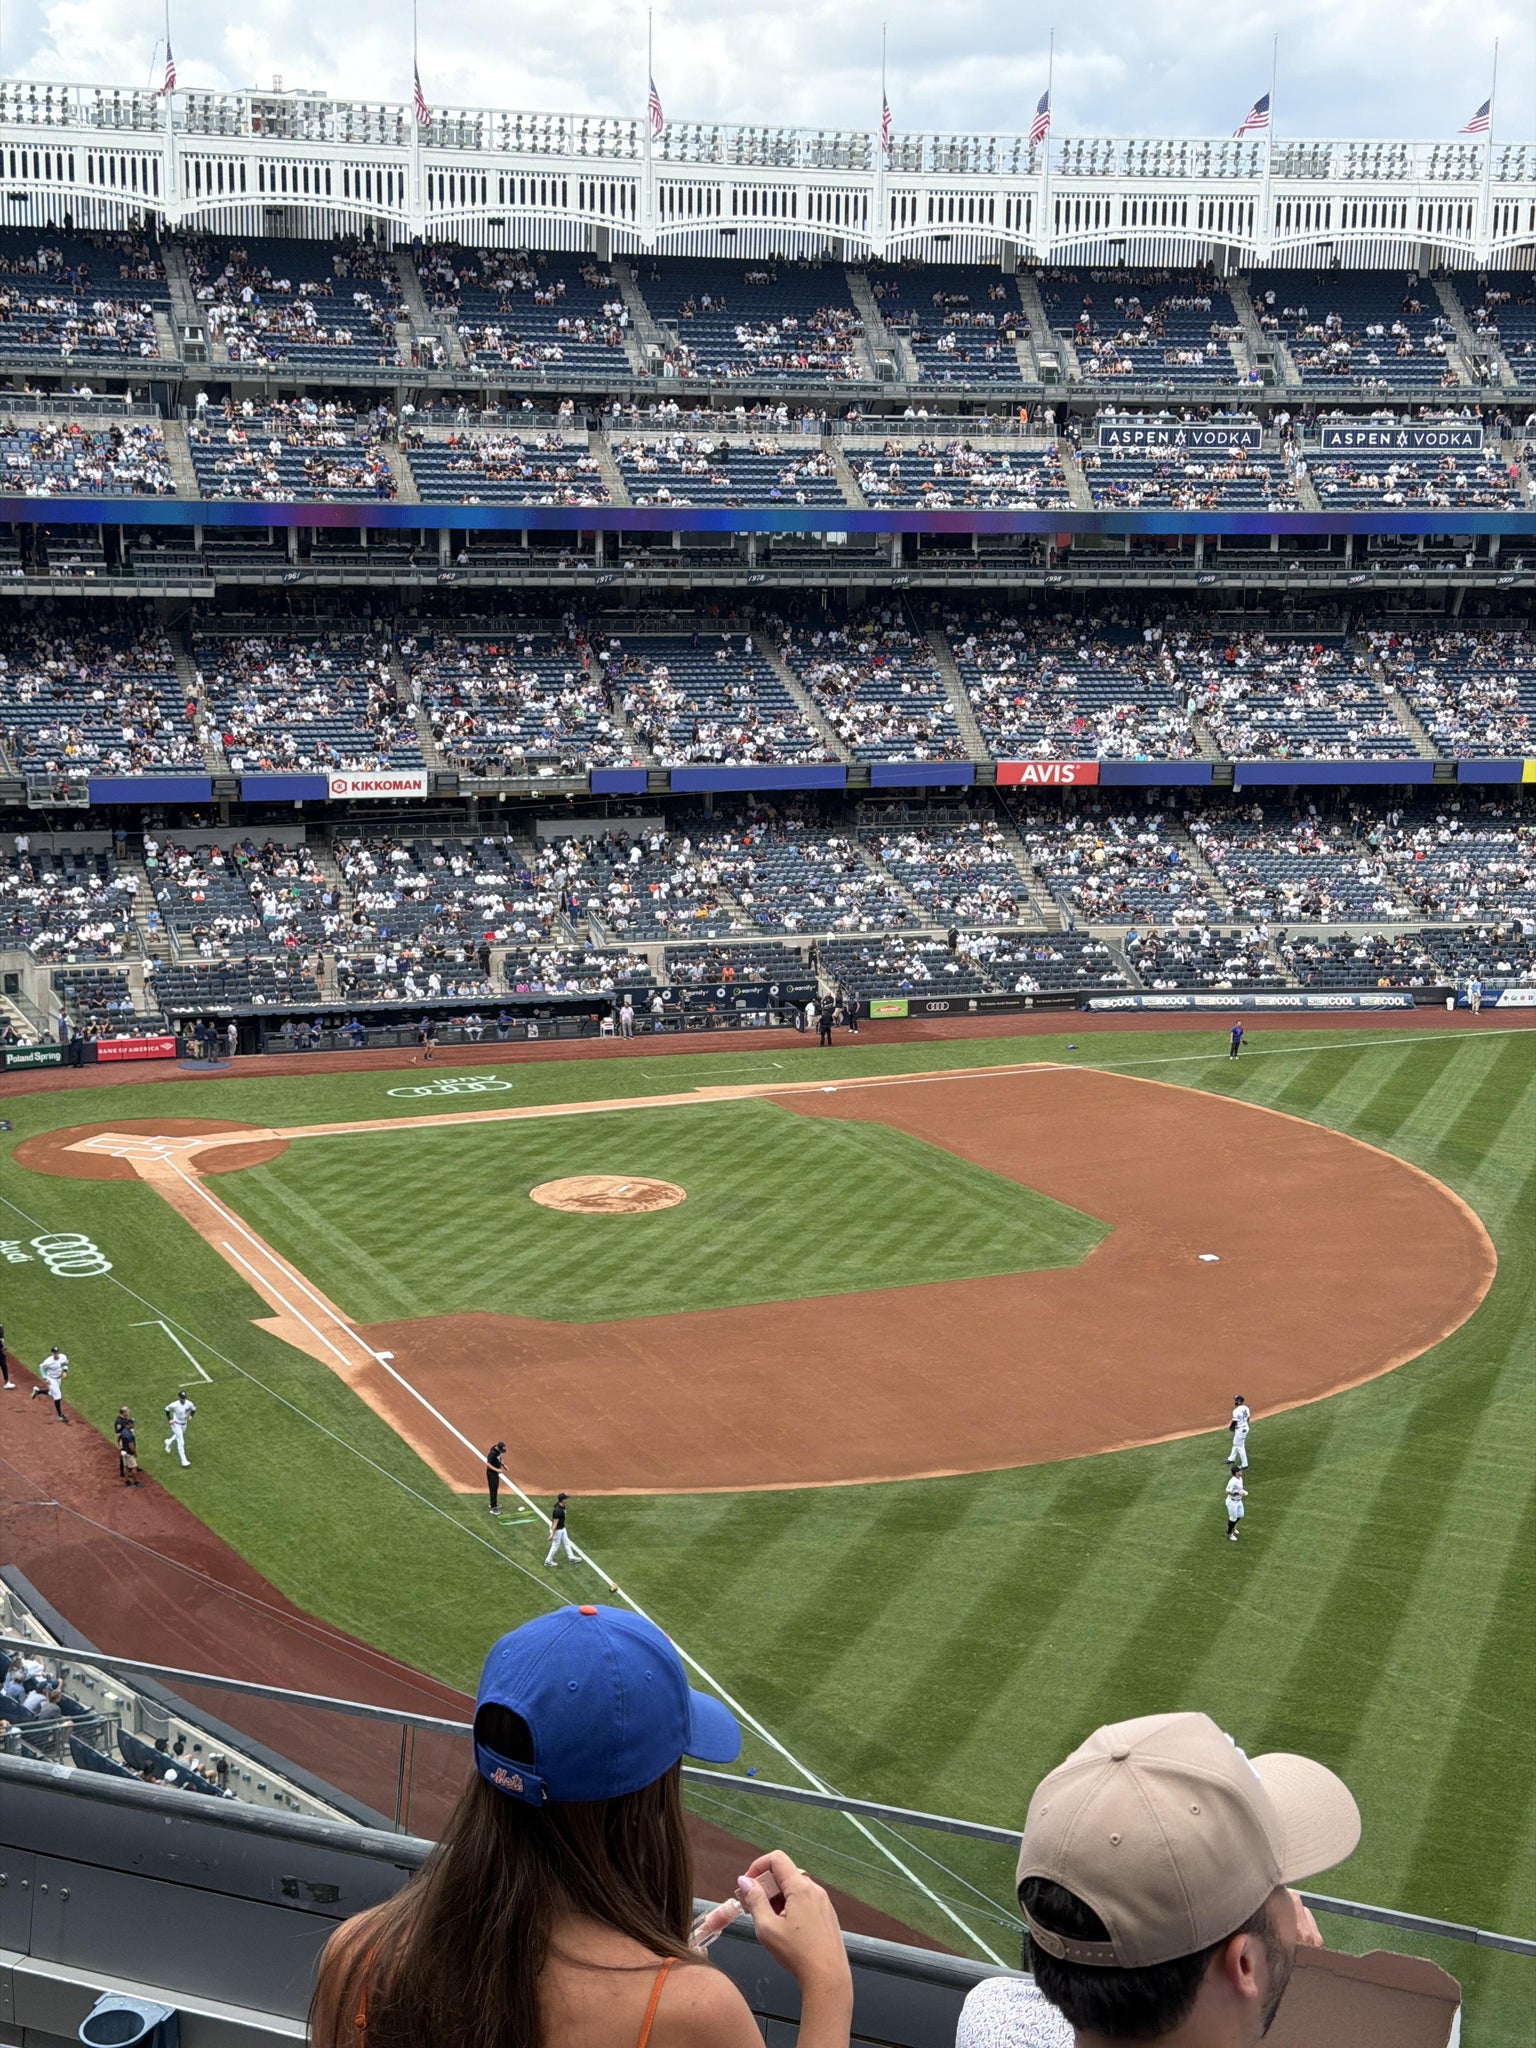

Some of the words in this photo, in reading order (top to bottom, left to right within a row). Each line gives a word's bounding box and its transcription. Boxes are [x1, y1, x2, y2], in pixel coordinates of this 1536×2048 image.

[1109, 430, 1168, 444] ASPEN
[1193, 431, 1252, 445] VODKA
[1331, 432, 1390, 445] ASPEN
[1414, 432, 1473, 446] VODKA
[283, 572, 300, 581] 1961
[437, 572, 456, 580] 1962
[596, 574, 613, 583] 1977
[748, 574, 765, 582] 1978
[1198, 575, 1216, 583] 1999
[1348, 574, 1366, 584] 2000
[1497, 576, 1514, 584] 2009
[1020, 764, 1075, 783] AVIS
[351, 780, 422, 791] KIKKOMAN
[128, 1045, 160, 1053] AMERICA
[6, 1052, 34, 1065] Poland
[34, 1051, 61, 1064] Spring
[432, 1074, 497, 1085] Audi
[0, 1240, 35, 1263] Audi
[490, 1767, 524, 1793] Mets
